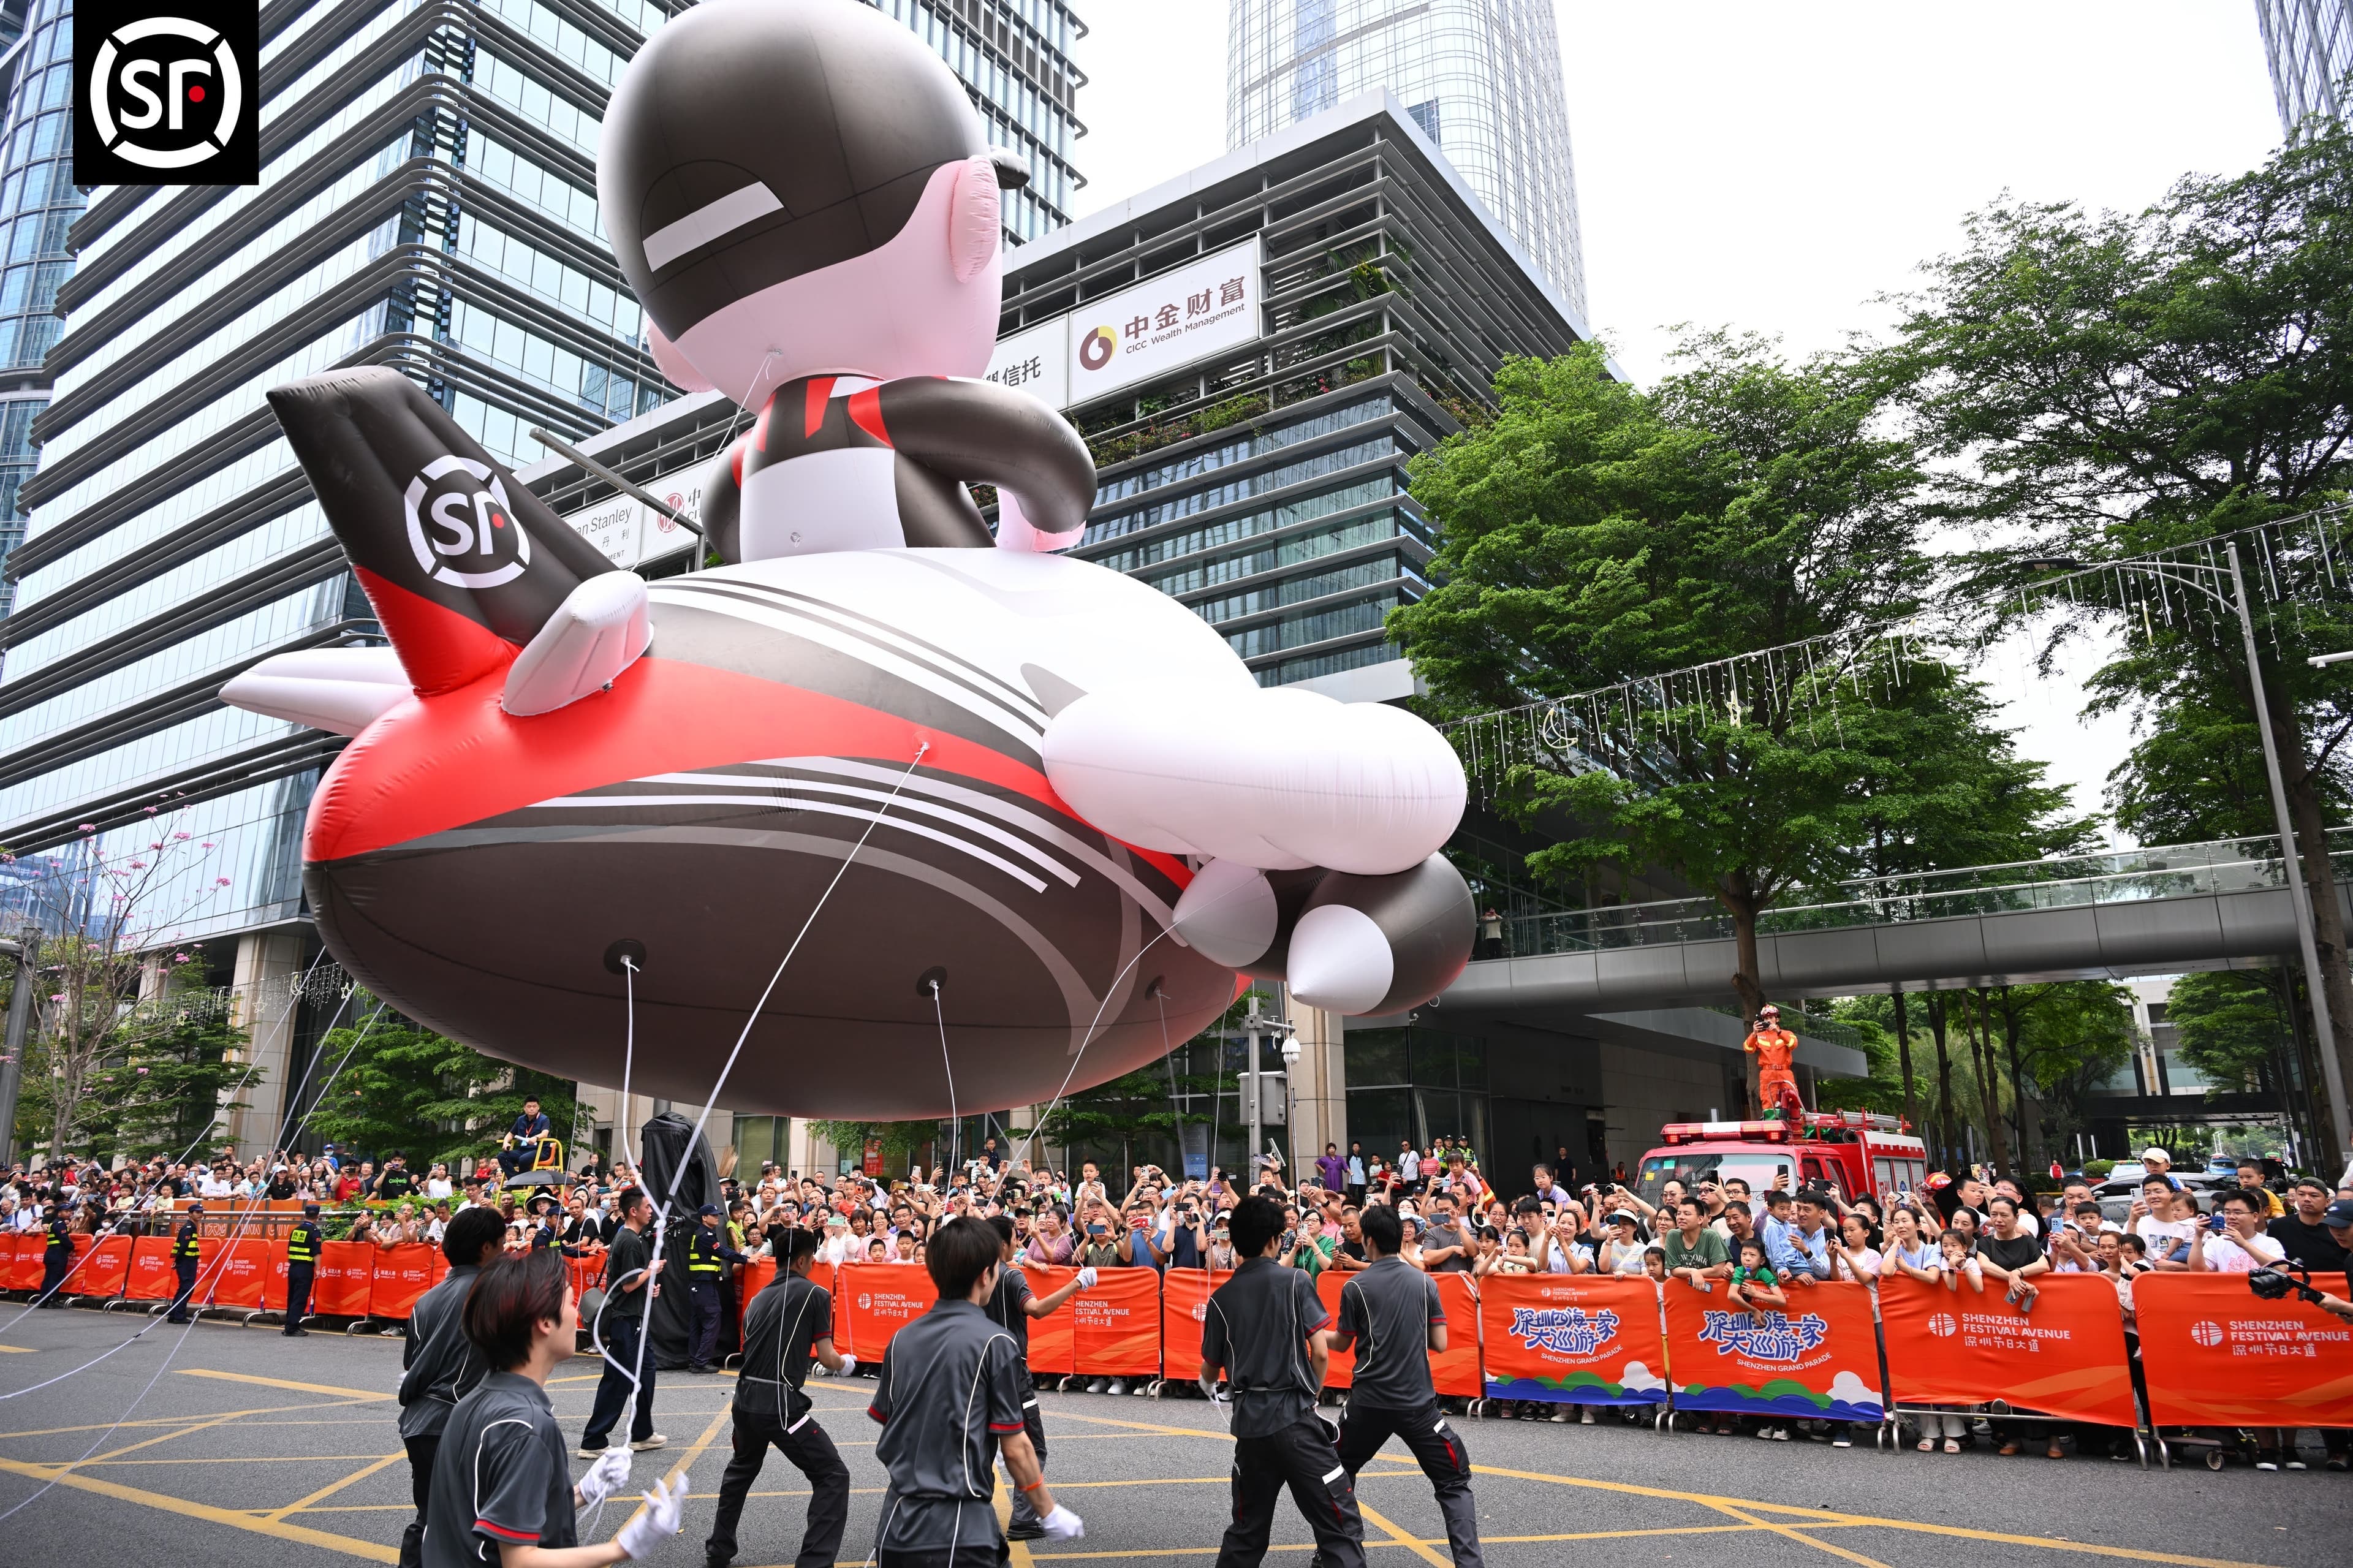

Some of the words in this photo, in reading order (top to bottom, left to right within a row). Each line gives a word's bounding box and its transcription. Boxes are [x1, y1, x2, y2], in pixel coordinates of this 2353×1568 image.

[1125, 276, 1245, 339] 中金财富
[1126, 341, 1147, 354] CICC
[1151, 328, 1181, 345] Wealth
[1185, 303, 1245, 333] Management
[591, 506, 632, 532] Stanley
[874, 1308, 908, 1318] 深圳节日大道
[1962, 1313, 2029, 1326] SHENZHEN
[1963, 1324, 2018, 1336] FESTIVAL
[2021, 1328, 2071, 1339] AVENUE
[2229, 1320, 2304, 1330] SHENZHEN
[1525, 1327, 1601, 1355] 大巡游
[1965, 1336, 2040, 1352] 深圳节日大道
[2230, 1331, 2292, 1341] FESTIVAL
[2296, 1331, 2350, 1341] AVENUE
[1540, 1352, 1575, 1364] SHENZHEN
[1600, 1344, 1623, 1360] PARADE
[1717, 1331, 1806, 1362] 大巡游
[2232, 1343, 2316, 1357] 深圳节日大道
[1737, 1358, 1776, 1371] SHENZHEN
[1778, 1363, 1804, 1372] GRAND
[1805, 1352, 1832, 1368] PARADE
